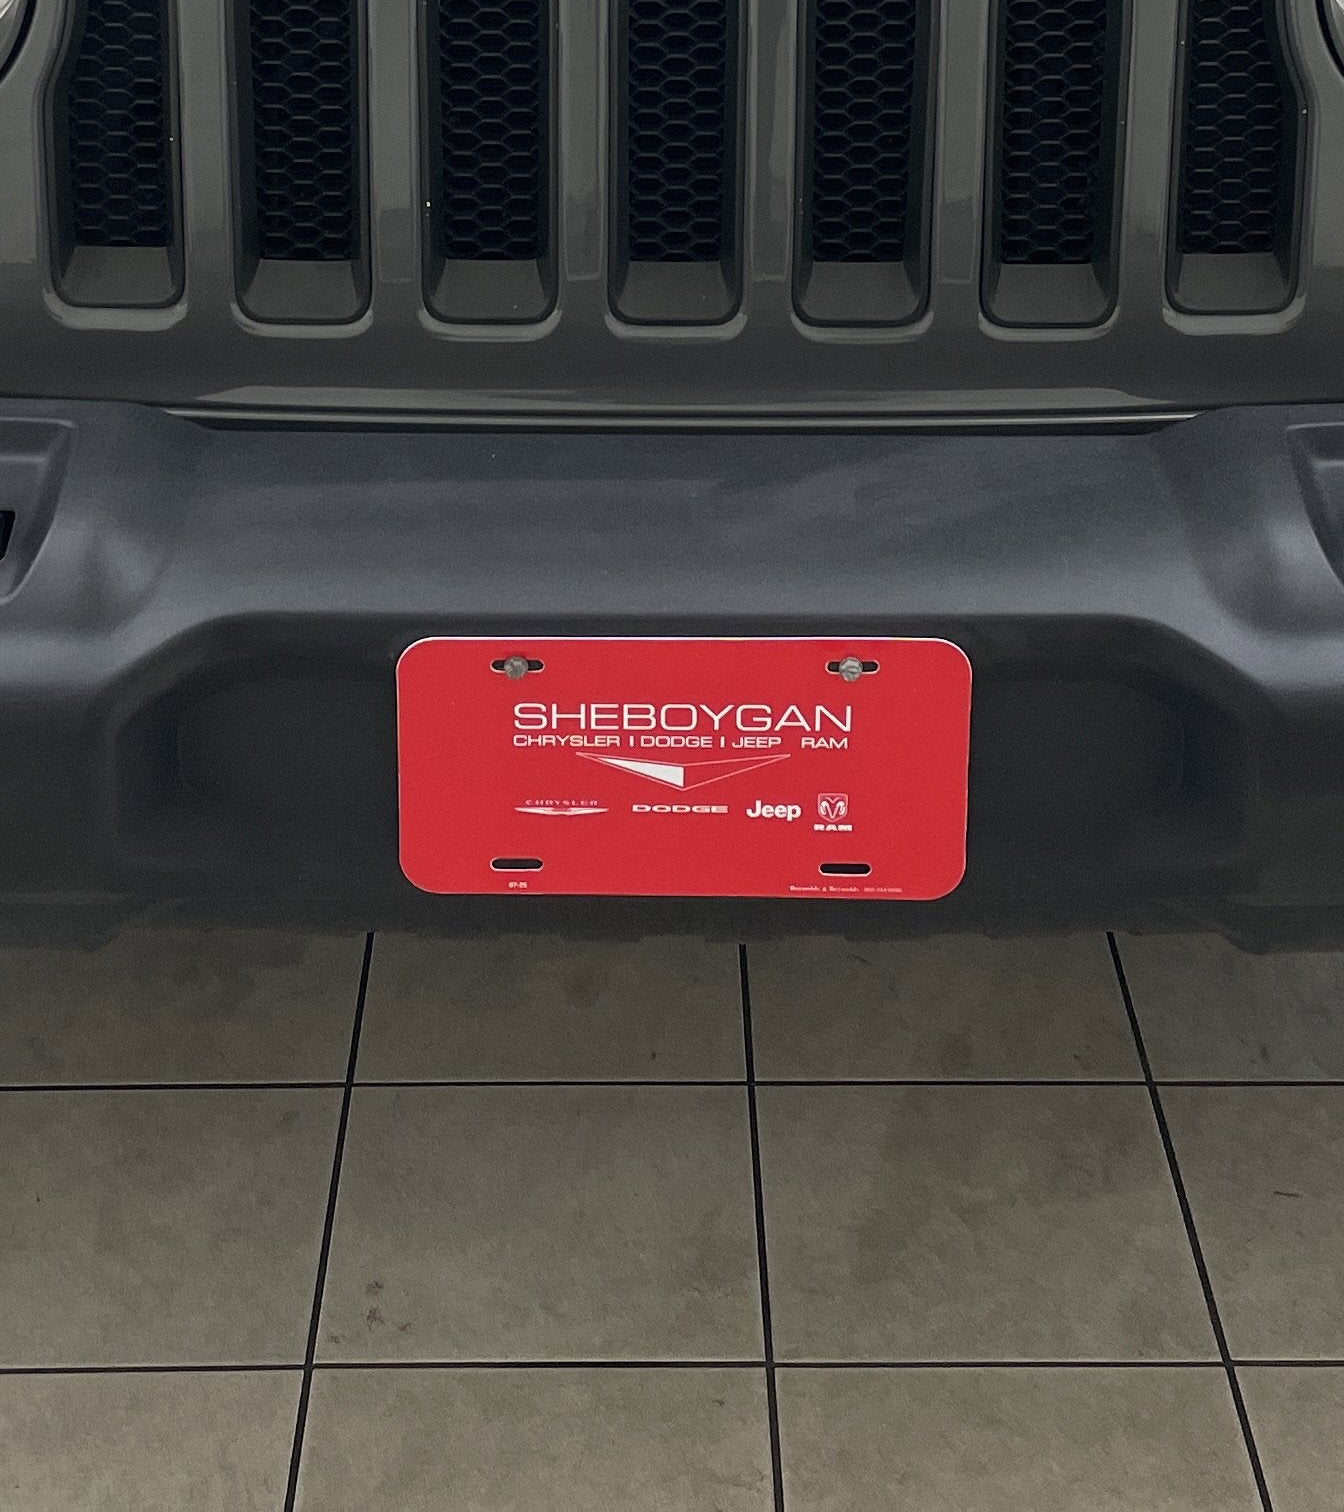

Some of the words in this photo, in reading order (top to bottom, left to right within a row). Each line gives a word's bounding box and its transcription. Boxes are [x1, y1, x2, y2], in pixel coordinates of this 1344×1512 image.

[513, 702, 852, 733] SHEBOYGAN
[513, 734, 621, 748] CHRYSLER
[640, 735, 713, 748] DODGE
[731, 736, 782, 749] JEEP
[801, 736, 849, 750] RAM
[632, 804, 729, 814] DODGE
[746, 799, 802, 822] Jeep
[813, 823, 853, 832] RAM
